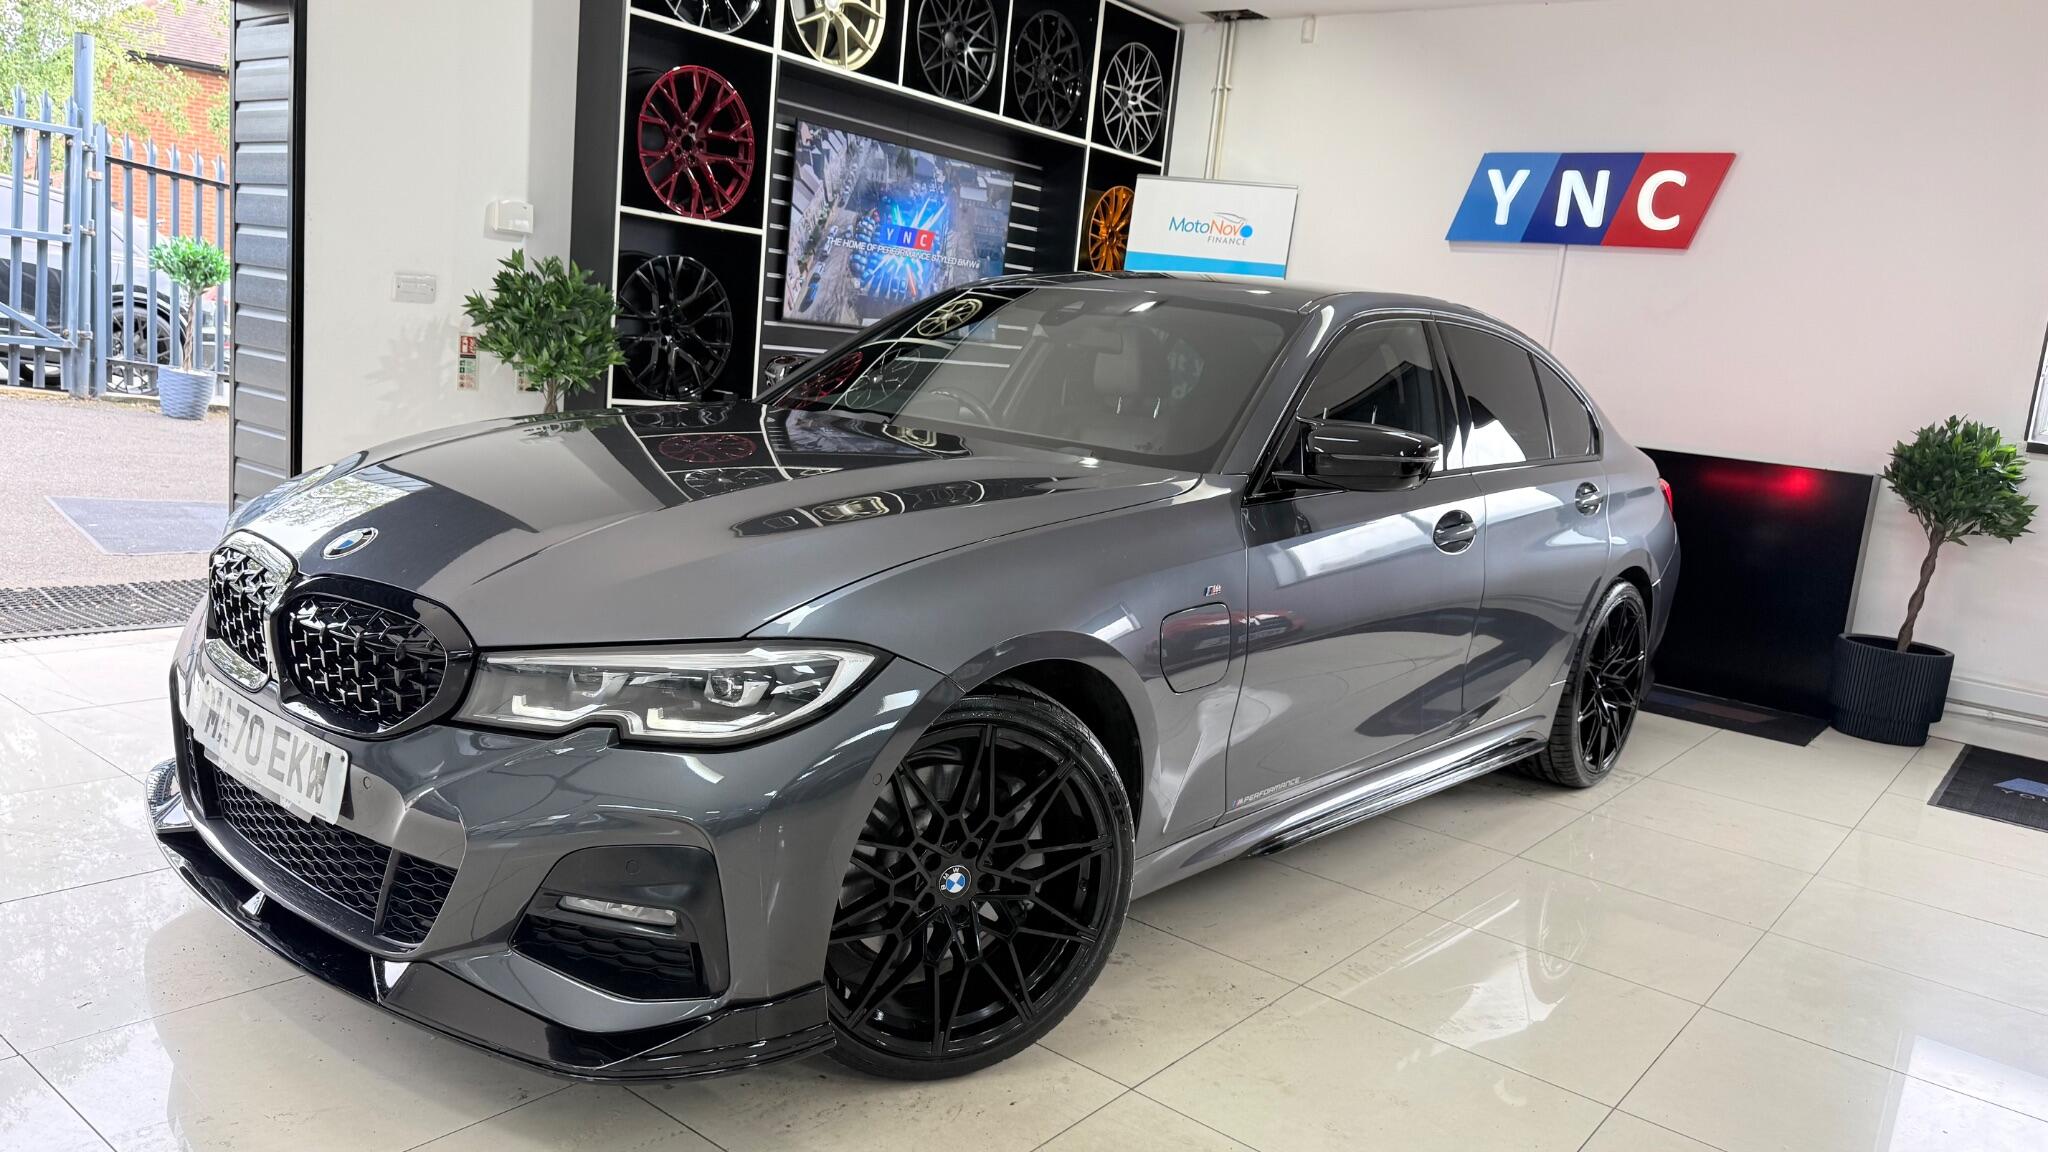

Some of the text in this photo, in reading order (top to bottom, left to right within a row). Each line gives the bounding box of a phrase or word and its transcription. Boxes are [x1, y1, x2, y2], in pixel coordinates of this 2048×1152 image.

[1487, 168, 1687, 231] YNC
[827, 236, 841, 247] THE
[842, 239, 867, 251] HOME
[867, 242, 878, 252] OF
[877, 245, 932, 262] PERFORMANCE
[932, 254, 956, 266] STYLED
[886, 228, 928, 247] YNC
[1207, 236, 1248, 247] FINANCE
[266, 724, 332, 805] EKW
[1243, 776, 1301, 804] PERFORMANCE
[940, 867, 960, 891] BMW
